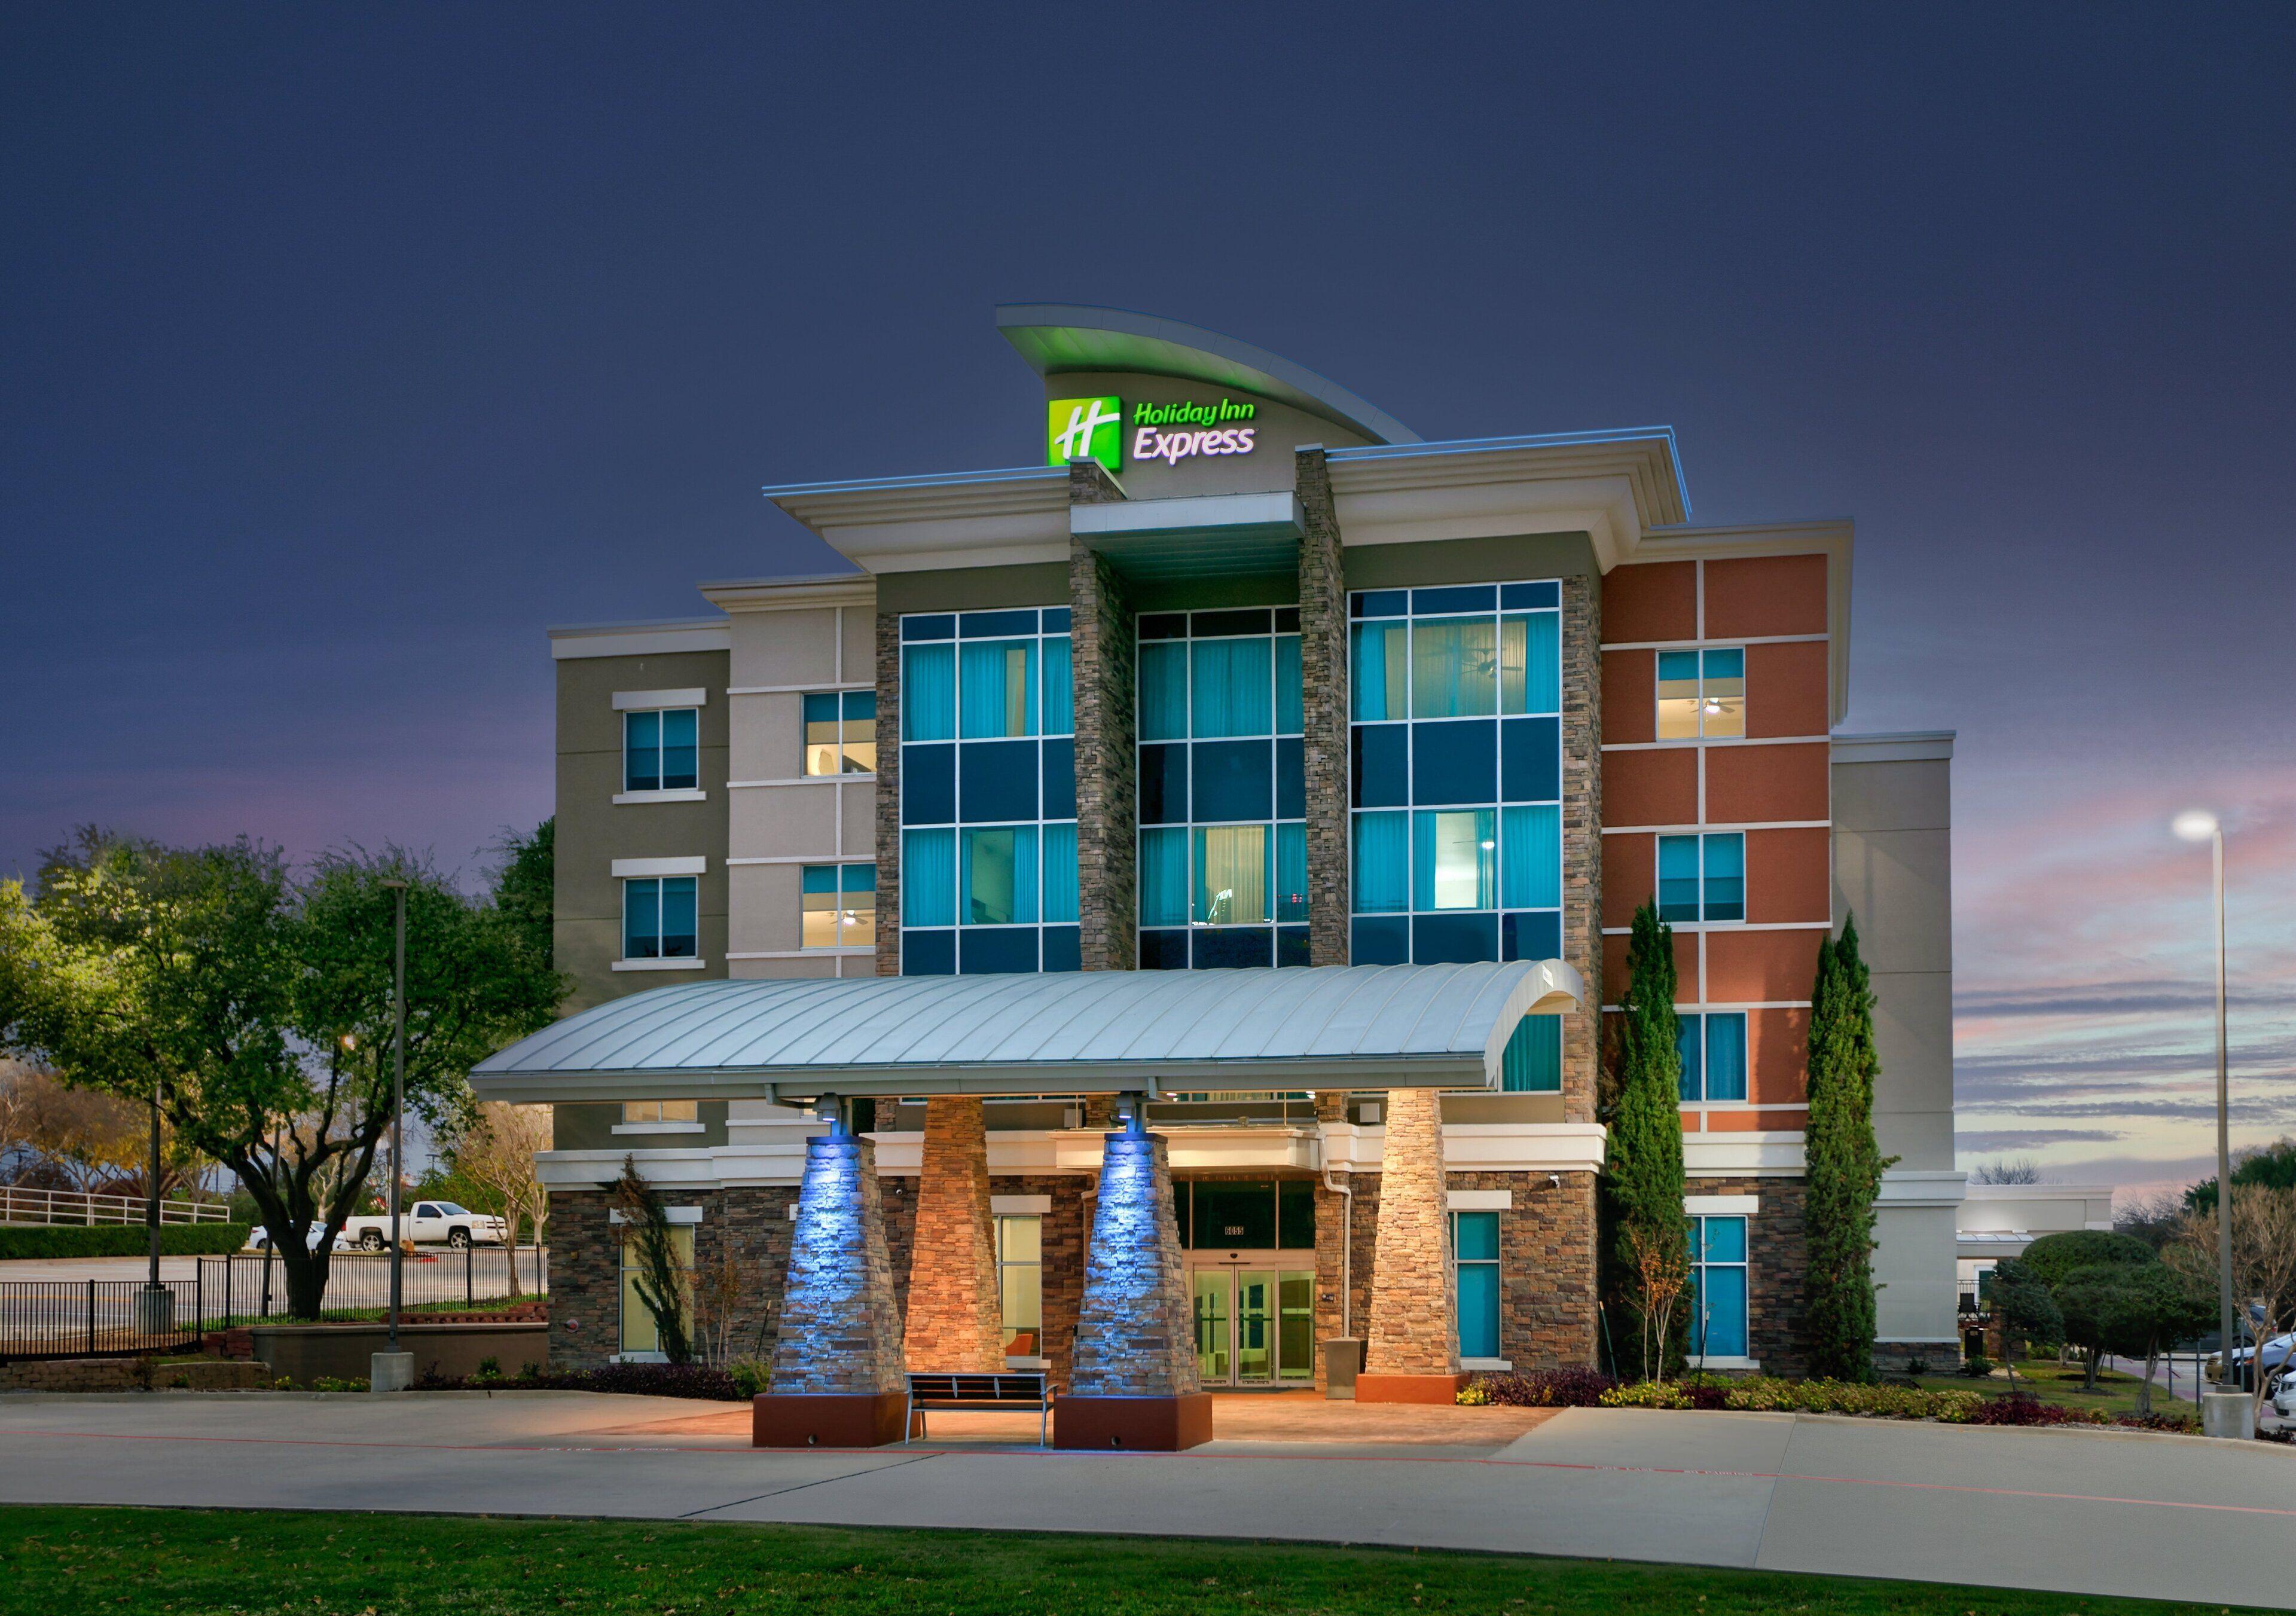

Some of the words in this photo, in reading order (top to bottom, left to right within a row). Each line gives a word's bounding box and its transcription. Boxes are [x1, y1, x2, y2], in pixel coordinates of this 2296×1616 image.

[1133, 401, 1217, 427] Holiday
[1219, 398, 1255, 421] Inn
[1134, 427, 1256, 466] Express
[1226, 1226, 1243, 1235] 6055
